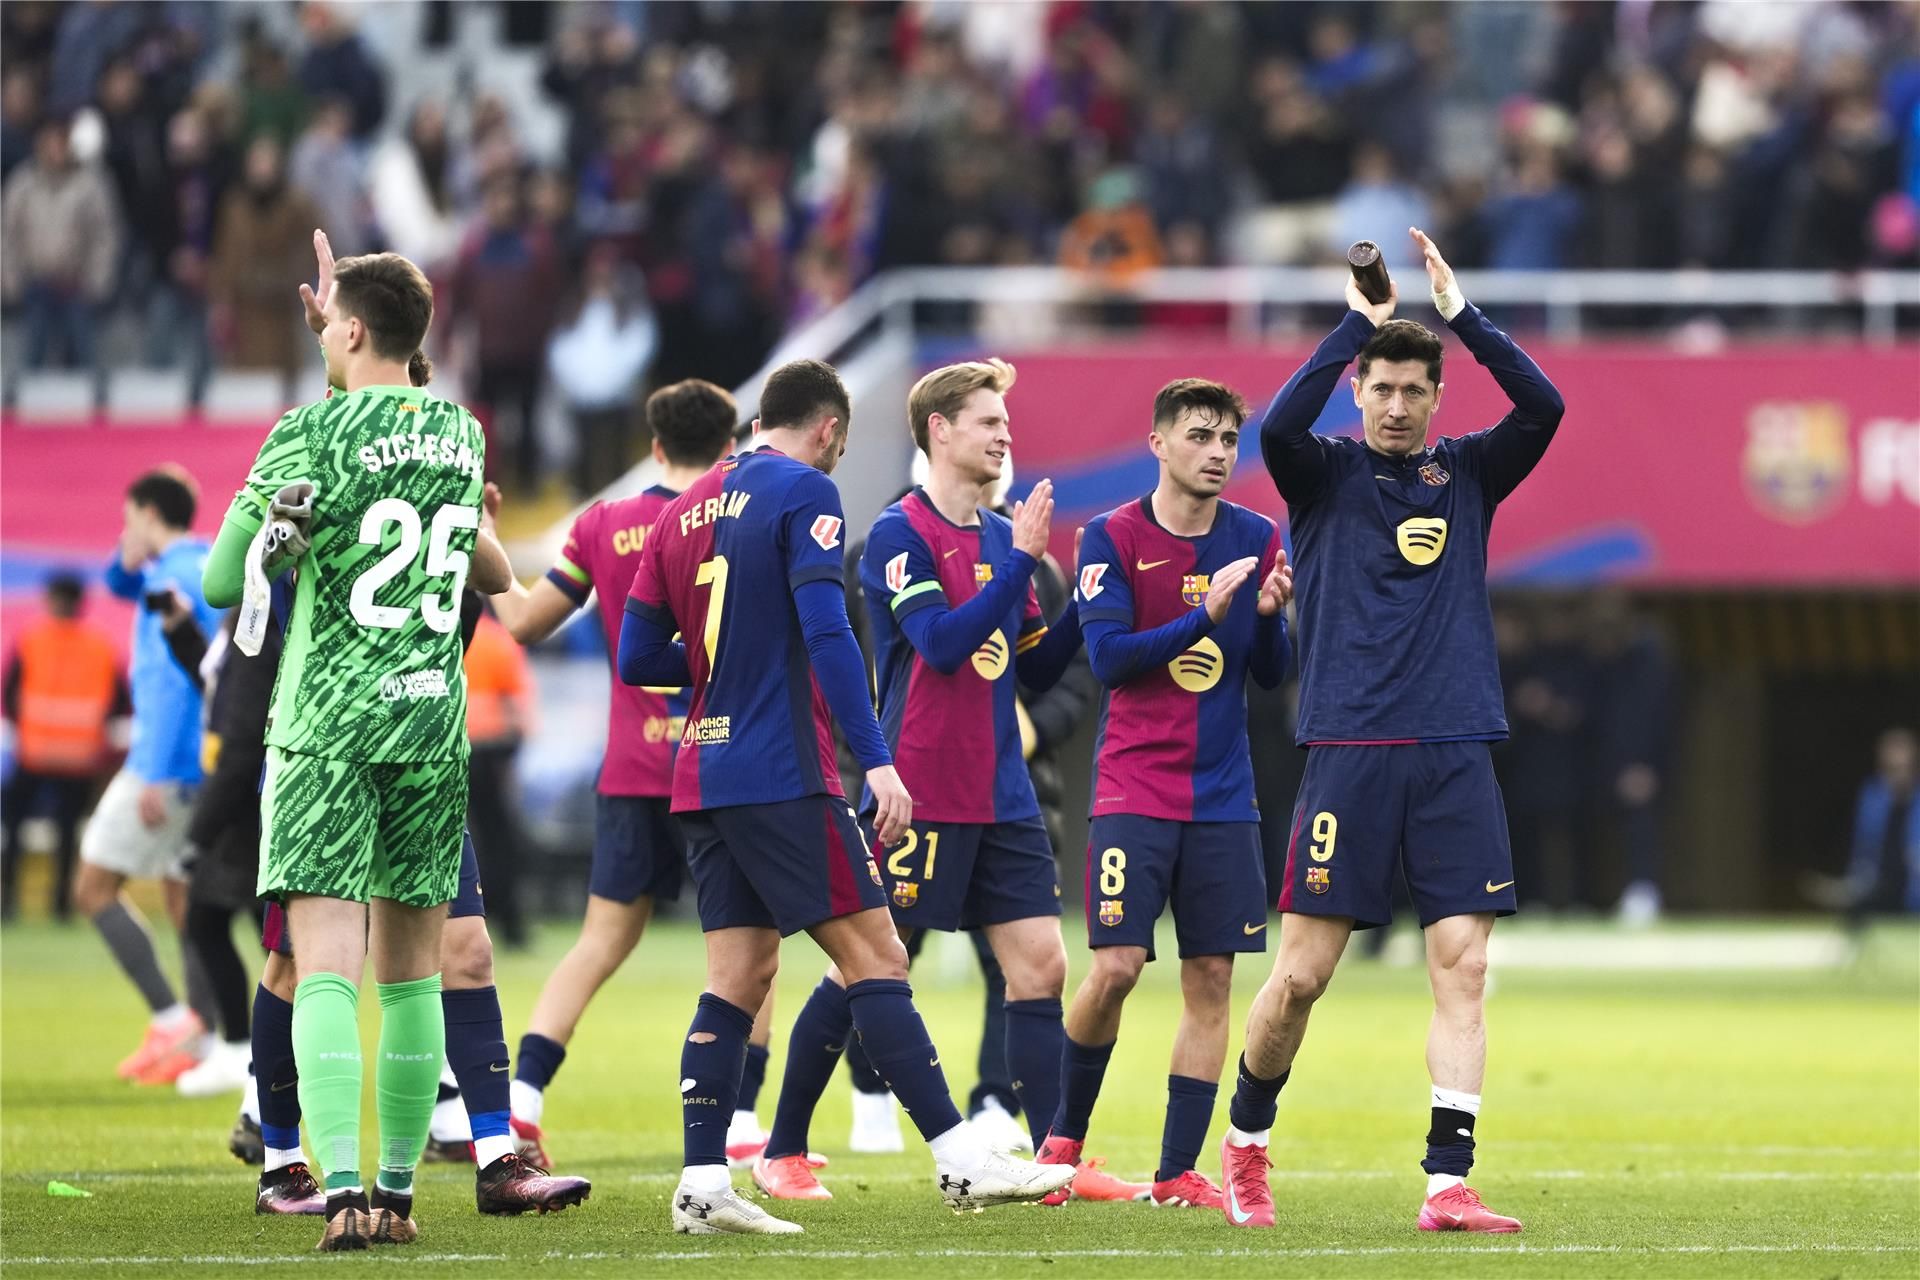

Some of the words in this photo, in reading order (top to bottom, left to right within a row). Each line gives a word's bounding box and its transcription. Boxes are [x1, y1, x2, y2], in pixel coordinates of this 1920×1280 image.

[680, 490, 751, 537] FERRAN
[612, 523, 655, 557] CU
[348, 497, 478, 634] 25
[694, 555, 729, 682] 7
[695, 727, 730, 742] ACNUR
[887, 828, 939, 880] 21
[1309, 811, 1338, 863] 9
[1100, 847, 1127, 896] 8
